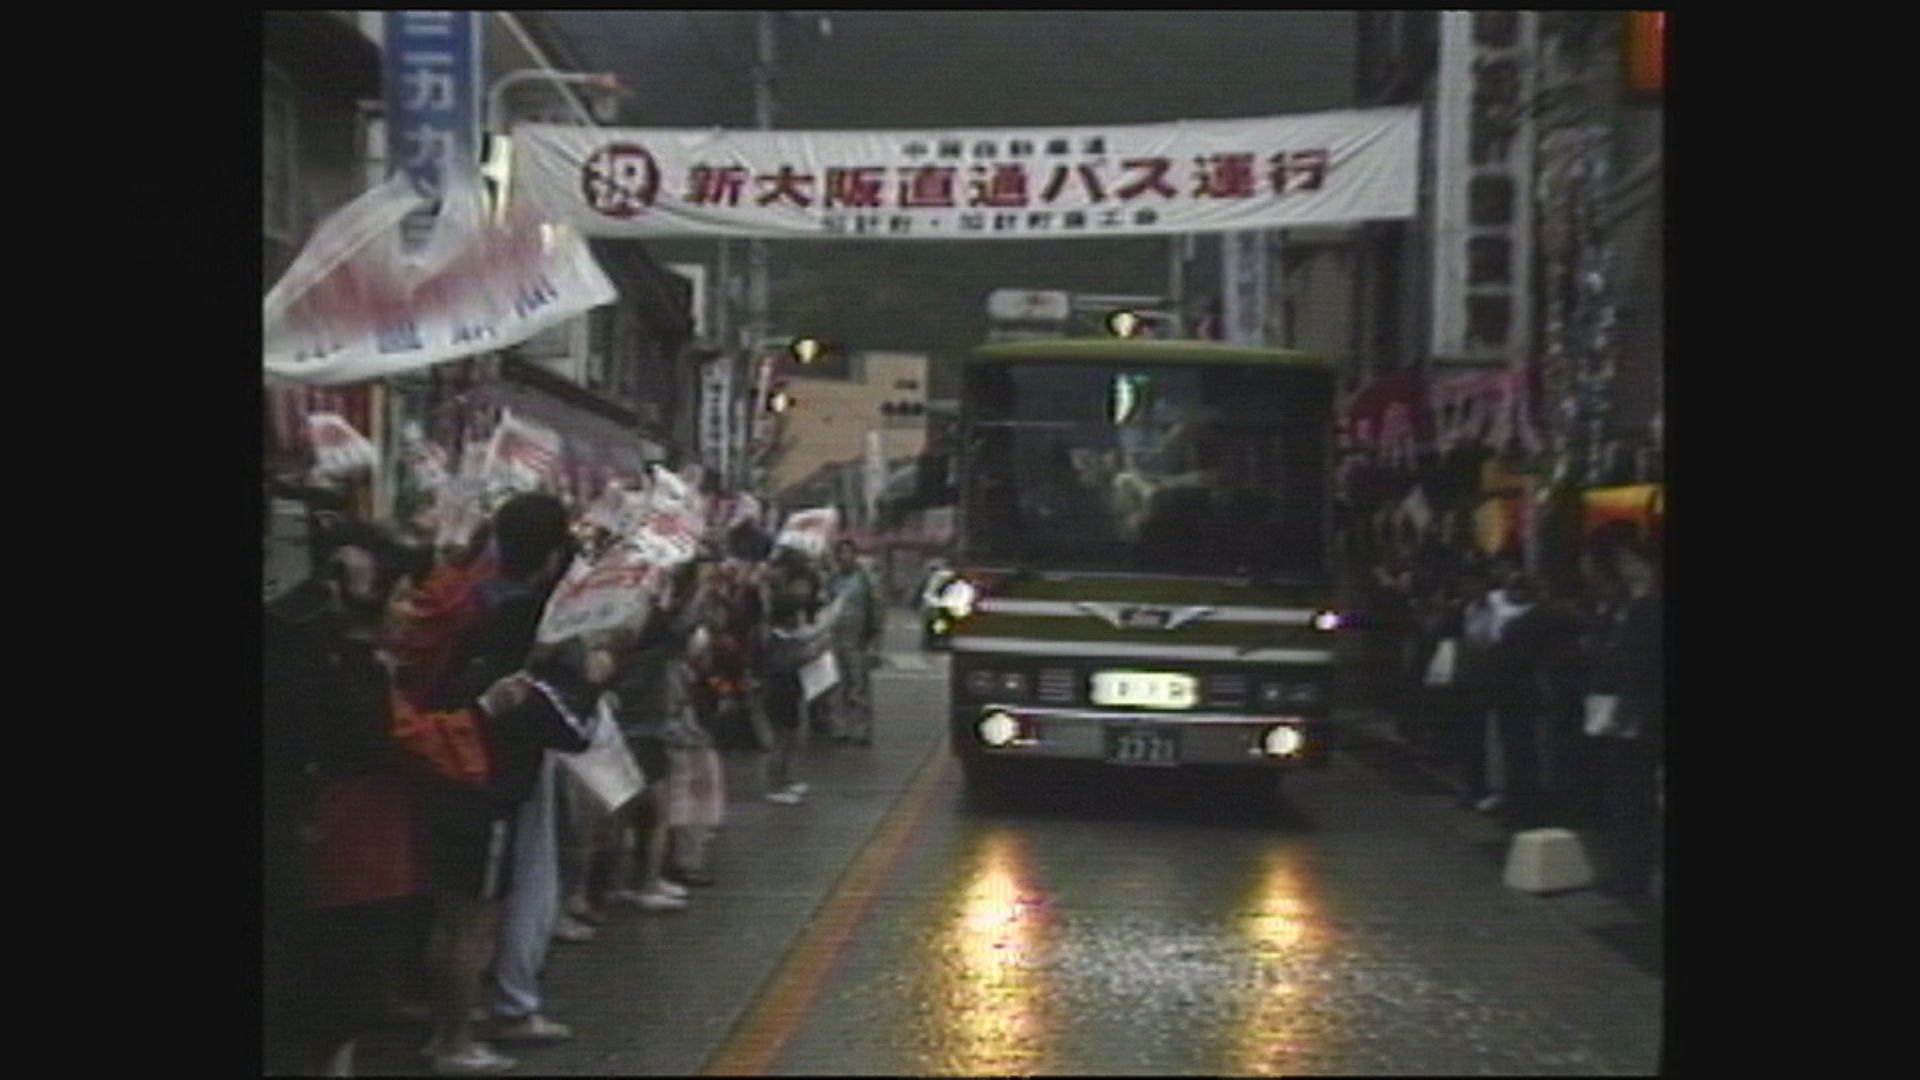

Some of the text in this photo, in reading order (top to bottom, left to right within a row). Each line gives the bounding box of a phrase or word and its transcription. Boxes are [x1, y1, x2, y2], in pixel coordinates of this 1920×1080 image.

[584, 143, 658, 216] 祝
[684, 148, 1330, 209] 新大阪直通バス運行
